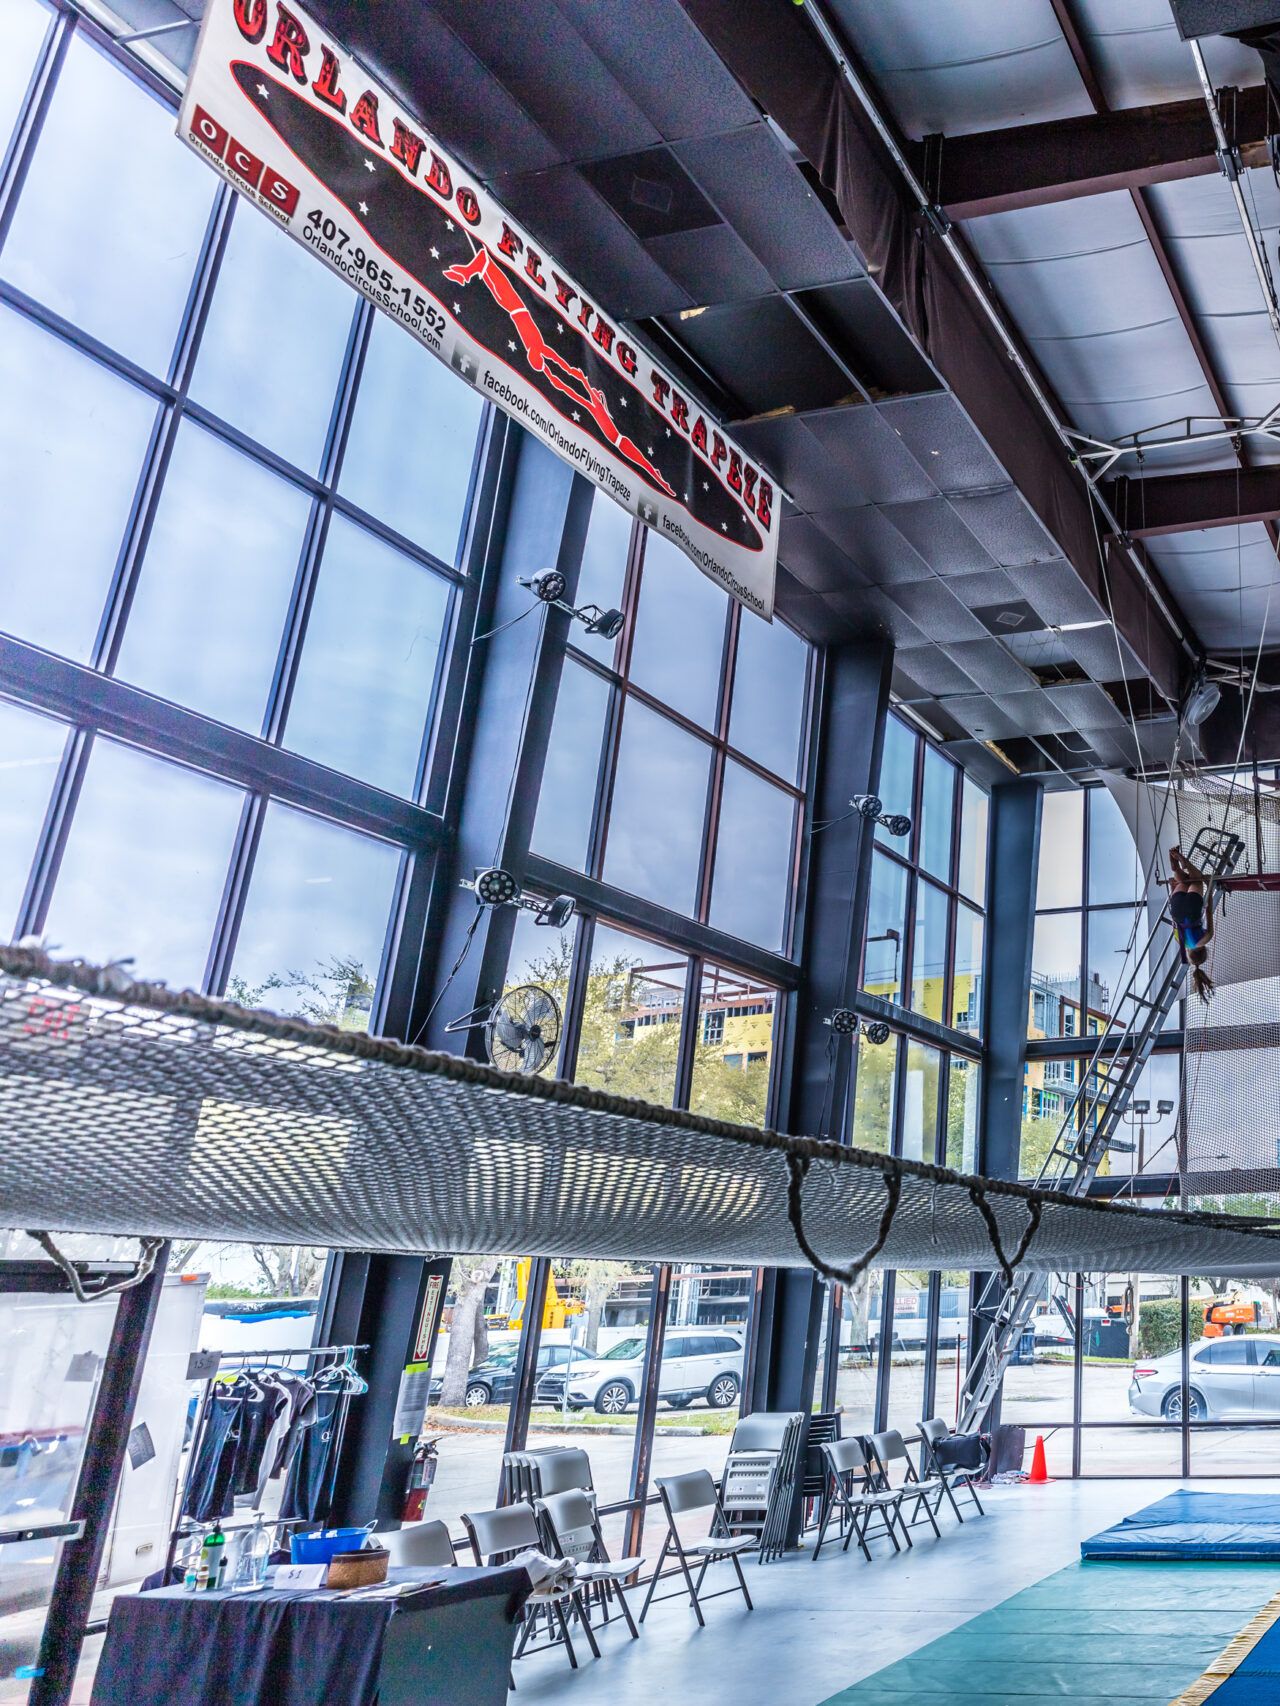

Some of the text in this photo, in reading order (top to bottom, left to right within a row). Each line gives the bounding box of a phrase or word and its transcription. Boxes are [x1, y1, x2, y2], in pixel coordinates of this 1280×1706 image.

[188, 132, 291, 226] Orlando Circus School
[199, 119, 289, 201] OCS
[233, 0, 773, 533] ORLANDO FLYING TRAPEZE
[302, 225, 441, 351] OrlandoCircusSchool.com
[307, 209, 446, 338] 407-965-1552
[483, 370, 631, 501] facebook.com/OrlandoFlyingTrapeze
[662, 514, 765, 611] facebook.com/OrlandoCircusSchool
